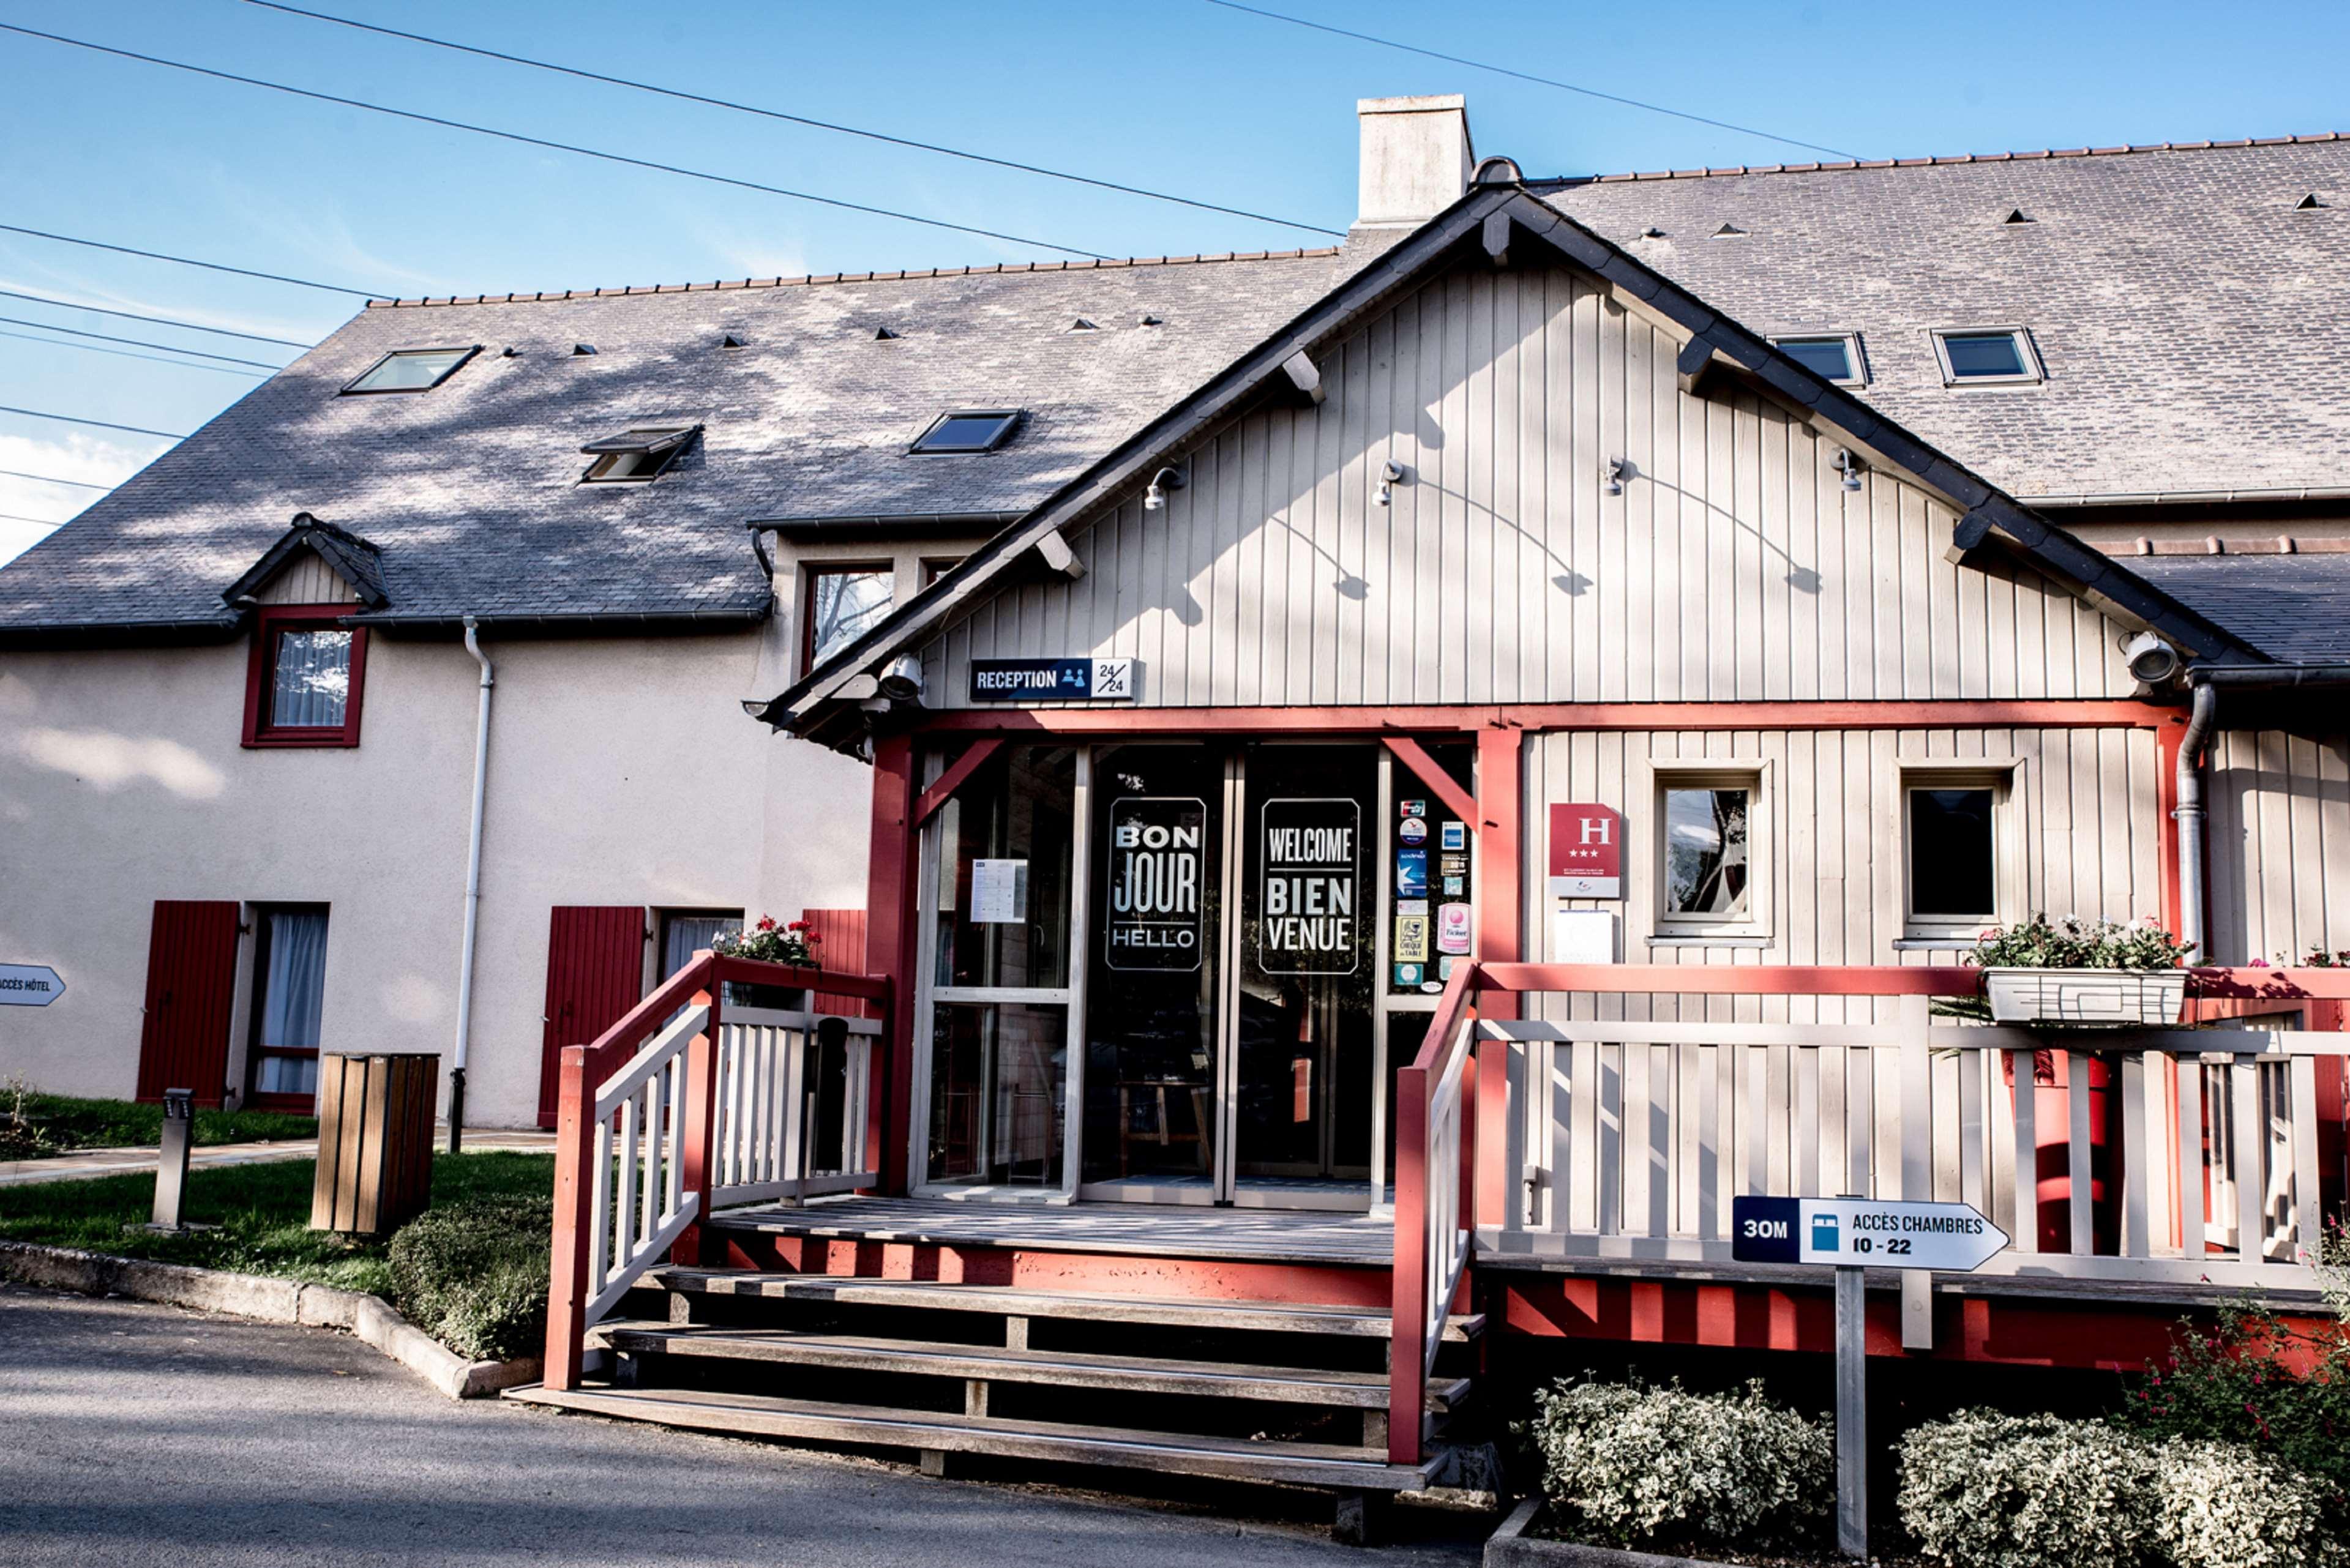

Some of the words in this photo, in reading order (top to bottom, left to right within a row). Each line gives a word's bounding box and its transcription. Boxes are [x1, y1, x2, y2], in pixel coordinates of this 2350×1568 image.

[977, 670, 1057, 689] RECEPTION
[1116, 826, 1199, 848] BON
[1578, 818, 1612, 845] H
[1269, 827, 1352, 862] WELCOME
[1114, 852, 1196, 913] JOUR
[1267, 877, 1352, 916] BIEN
[1112, 928, 1195, 948] HELLO
[1267, 917, 1351, 950] VENUE
[24, 978, 50, 991] HÔTEL
[1744, 1219, 1787, 1239] 30M
[1852, 1211, 1899, 1231] ACCÈS
[1902, 1215, 1983, 1234] CHAMBRES
[1853, 1238, 1872, 1253] 10
[1887, 1239, 1912, 1255] 22
